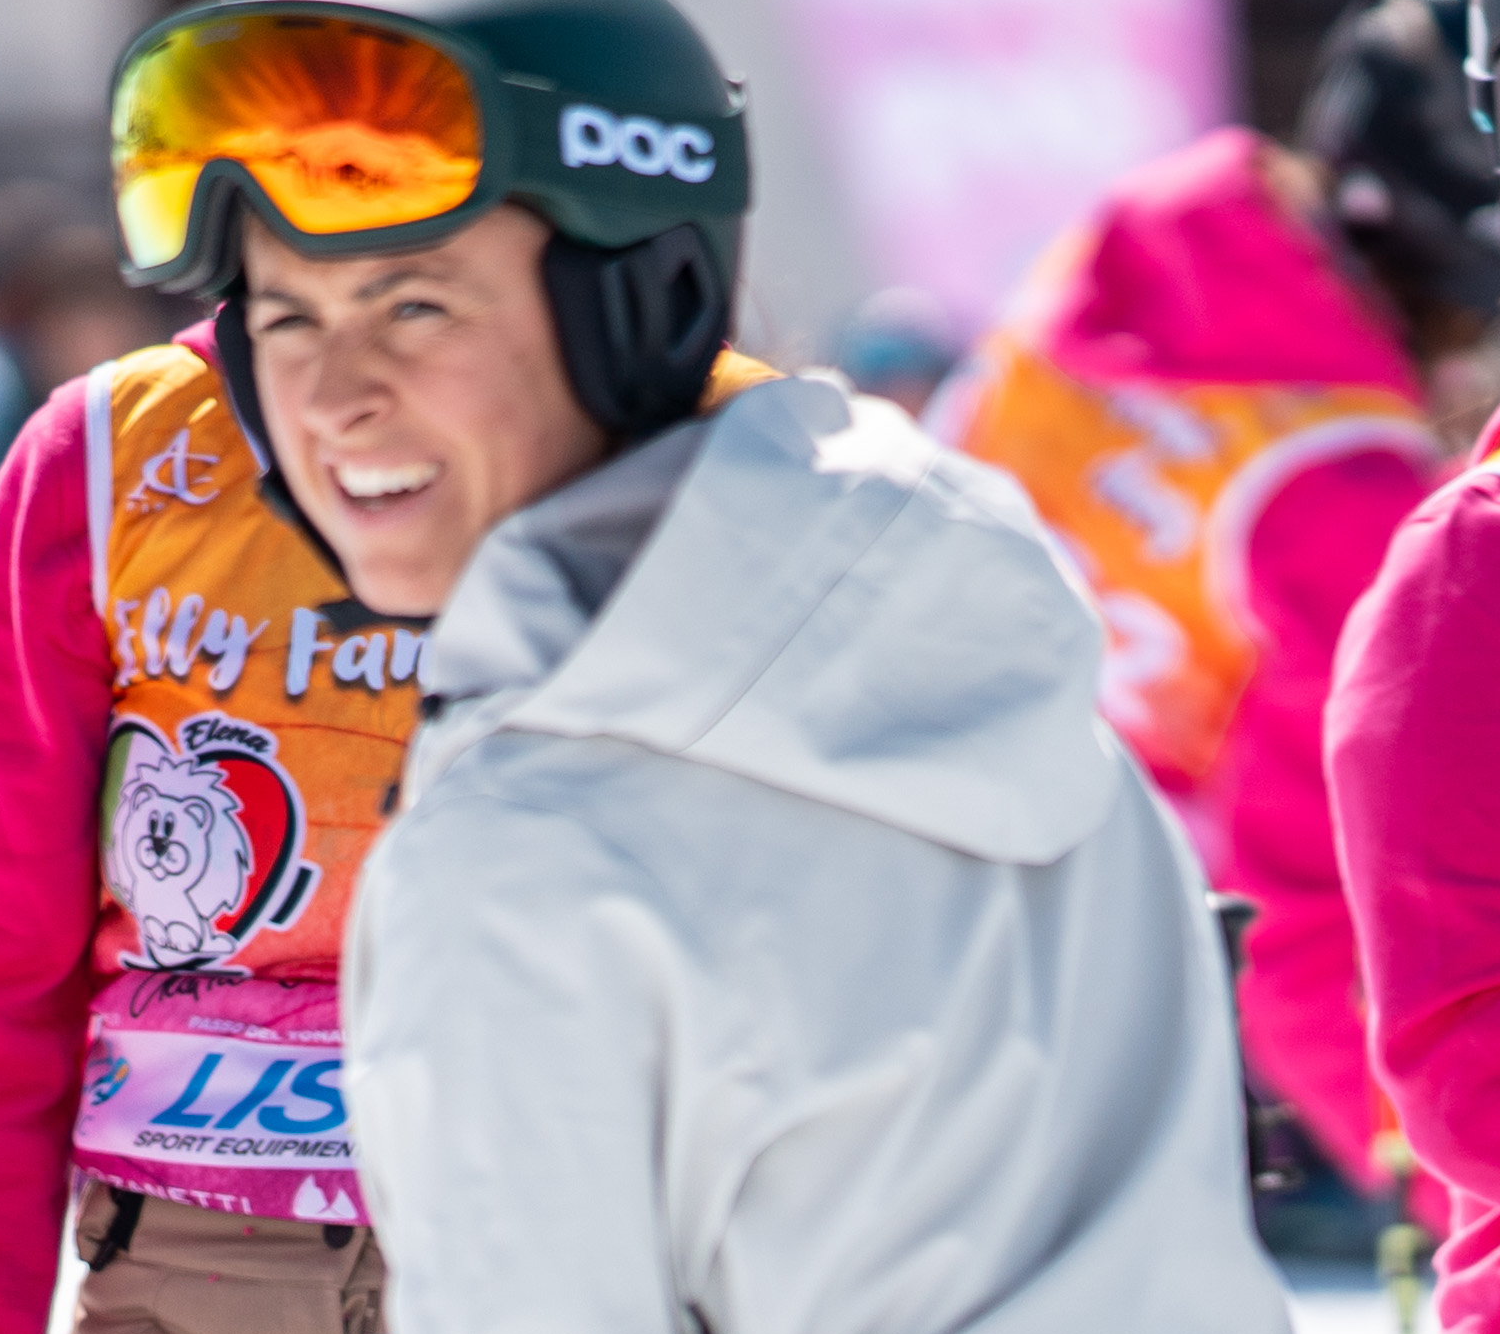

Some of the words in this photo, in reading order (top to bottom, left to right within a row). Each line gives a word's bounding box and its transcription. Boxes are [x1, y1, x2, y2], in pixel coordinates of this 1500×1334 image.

[114, 586, 271, 691] Elly
[182, 717, 270, 754] Elena
[149, 1052, 348, 1135] LIS
[133, 1130, 214, 1153] SPORT
[213, 1136, 357, 1159] EQUIPMEN
